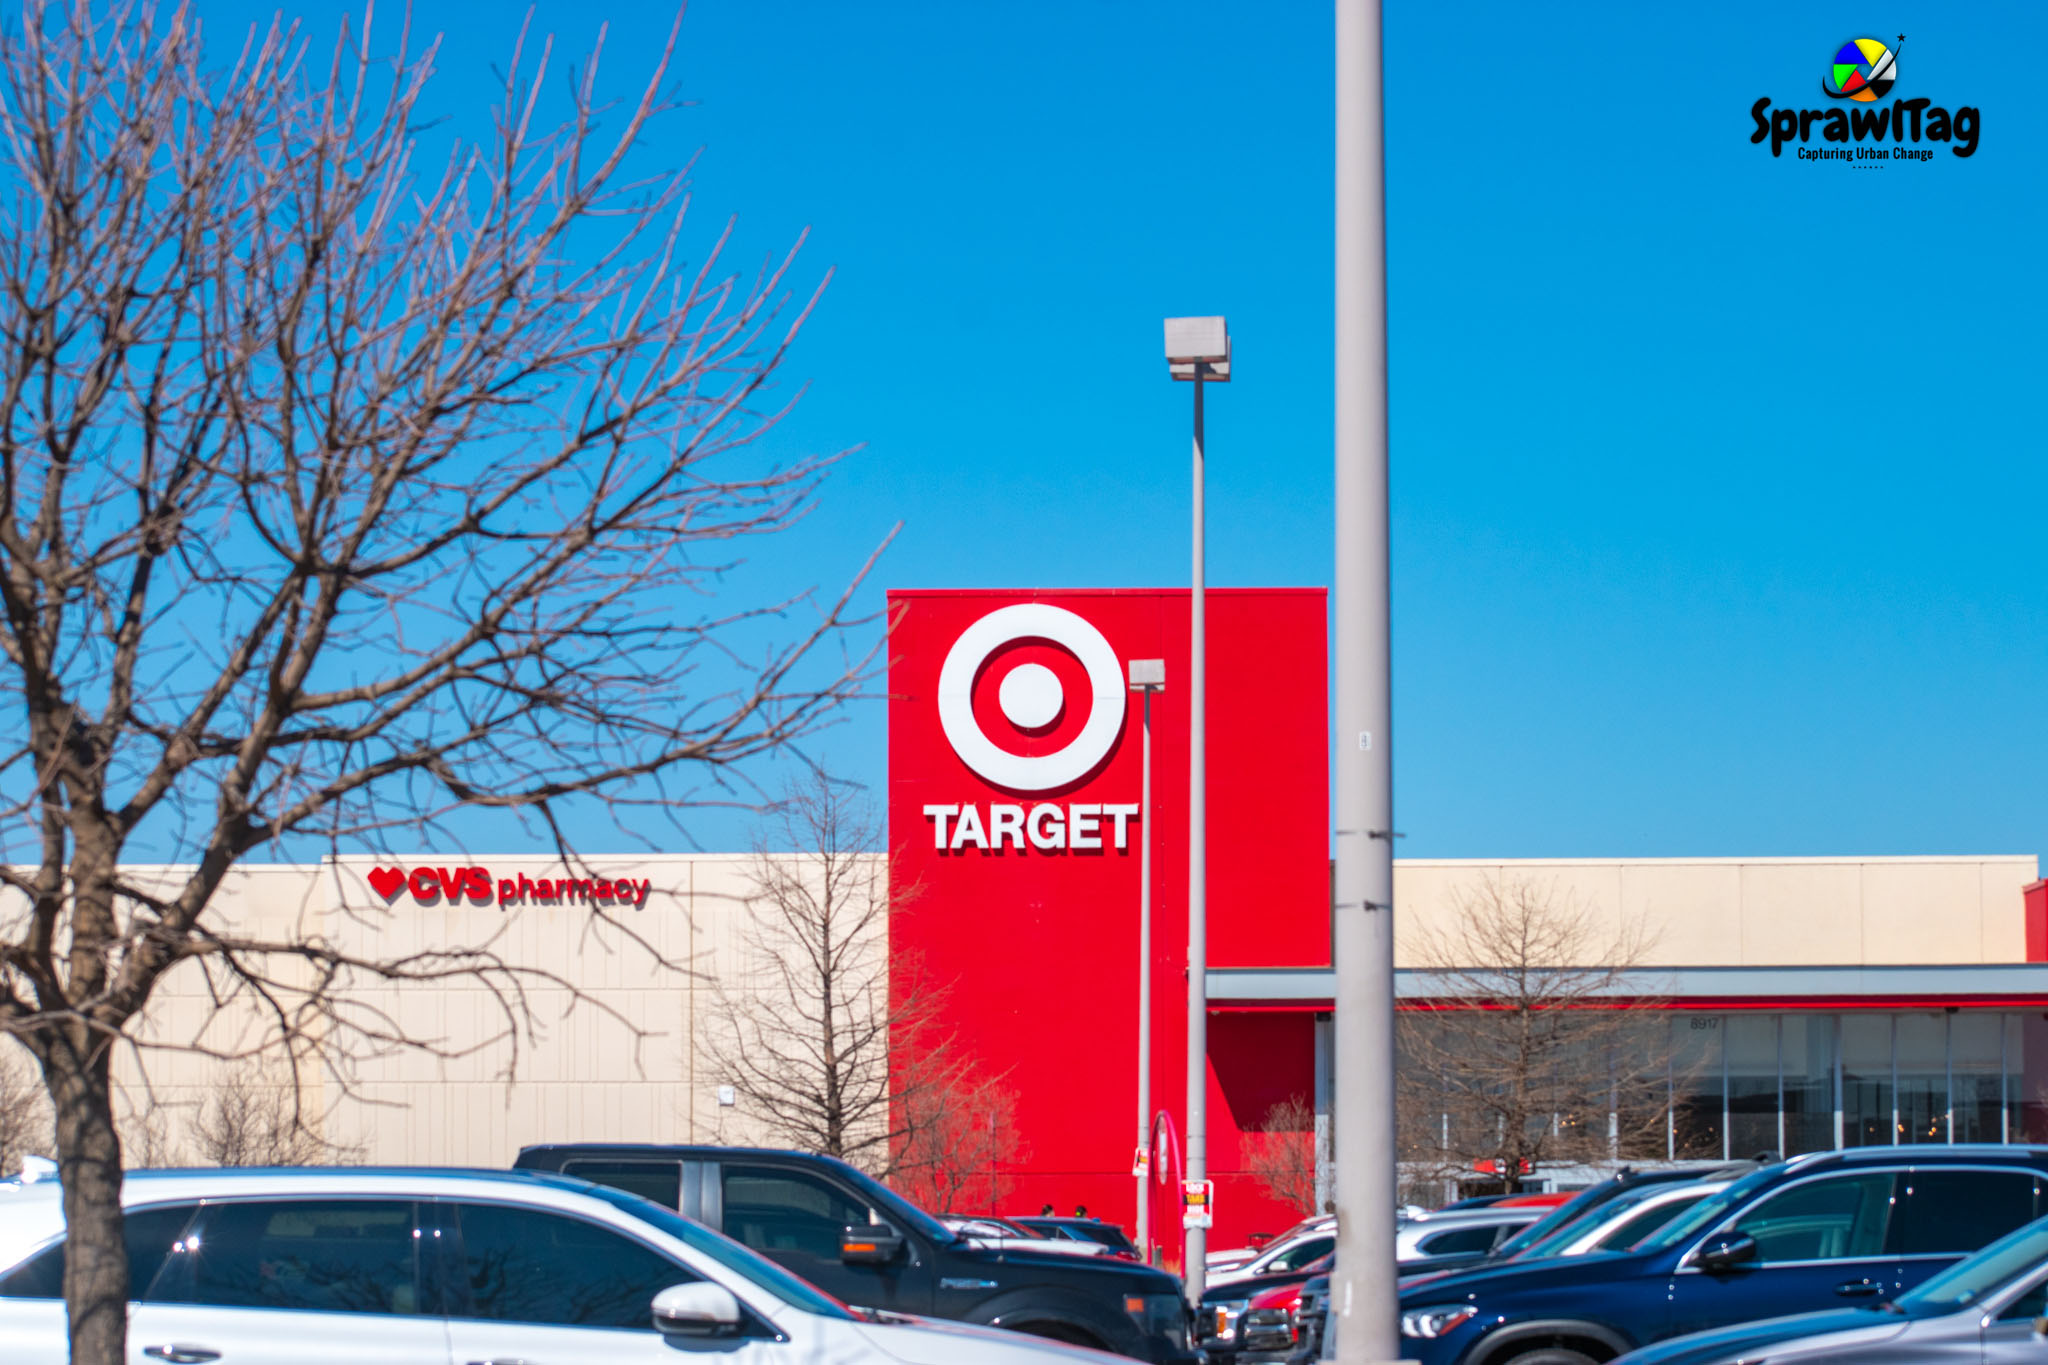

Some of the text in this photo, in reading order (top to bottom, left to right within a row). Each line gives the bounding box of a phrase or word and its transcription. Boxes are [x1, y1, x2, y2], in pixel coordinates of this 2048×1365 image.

[923, 802, 1138, 849] TARGET
[408, 867, 649, 906] CVS pharmacy
